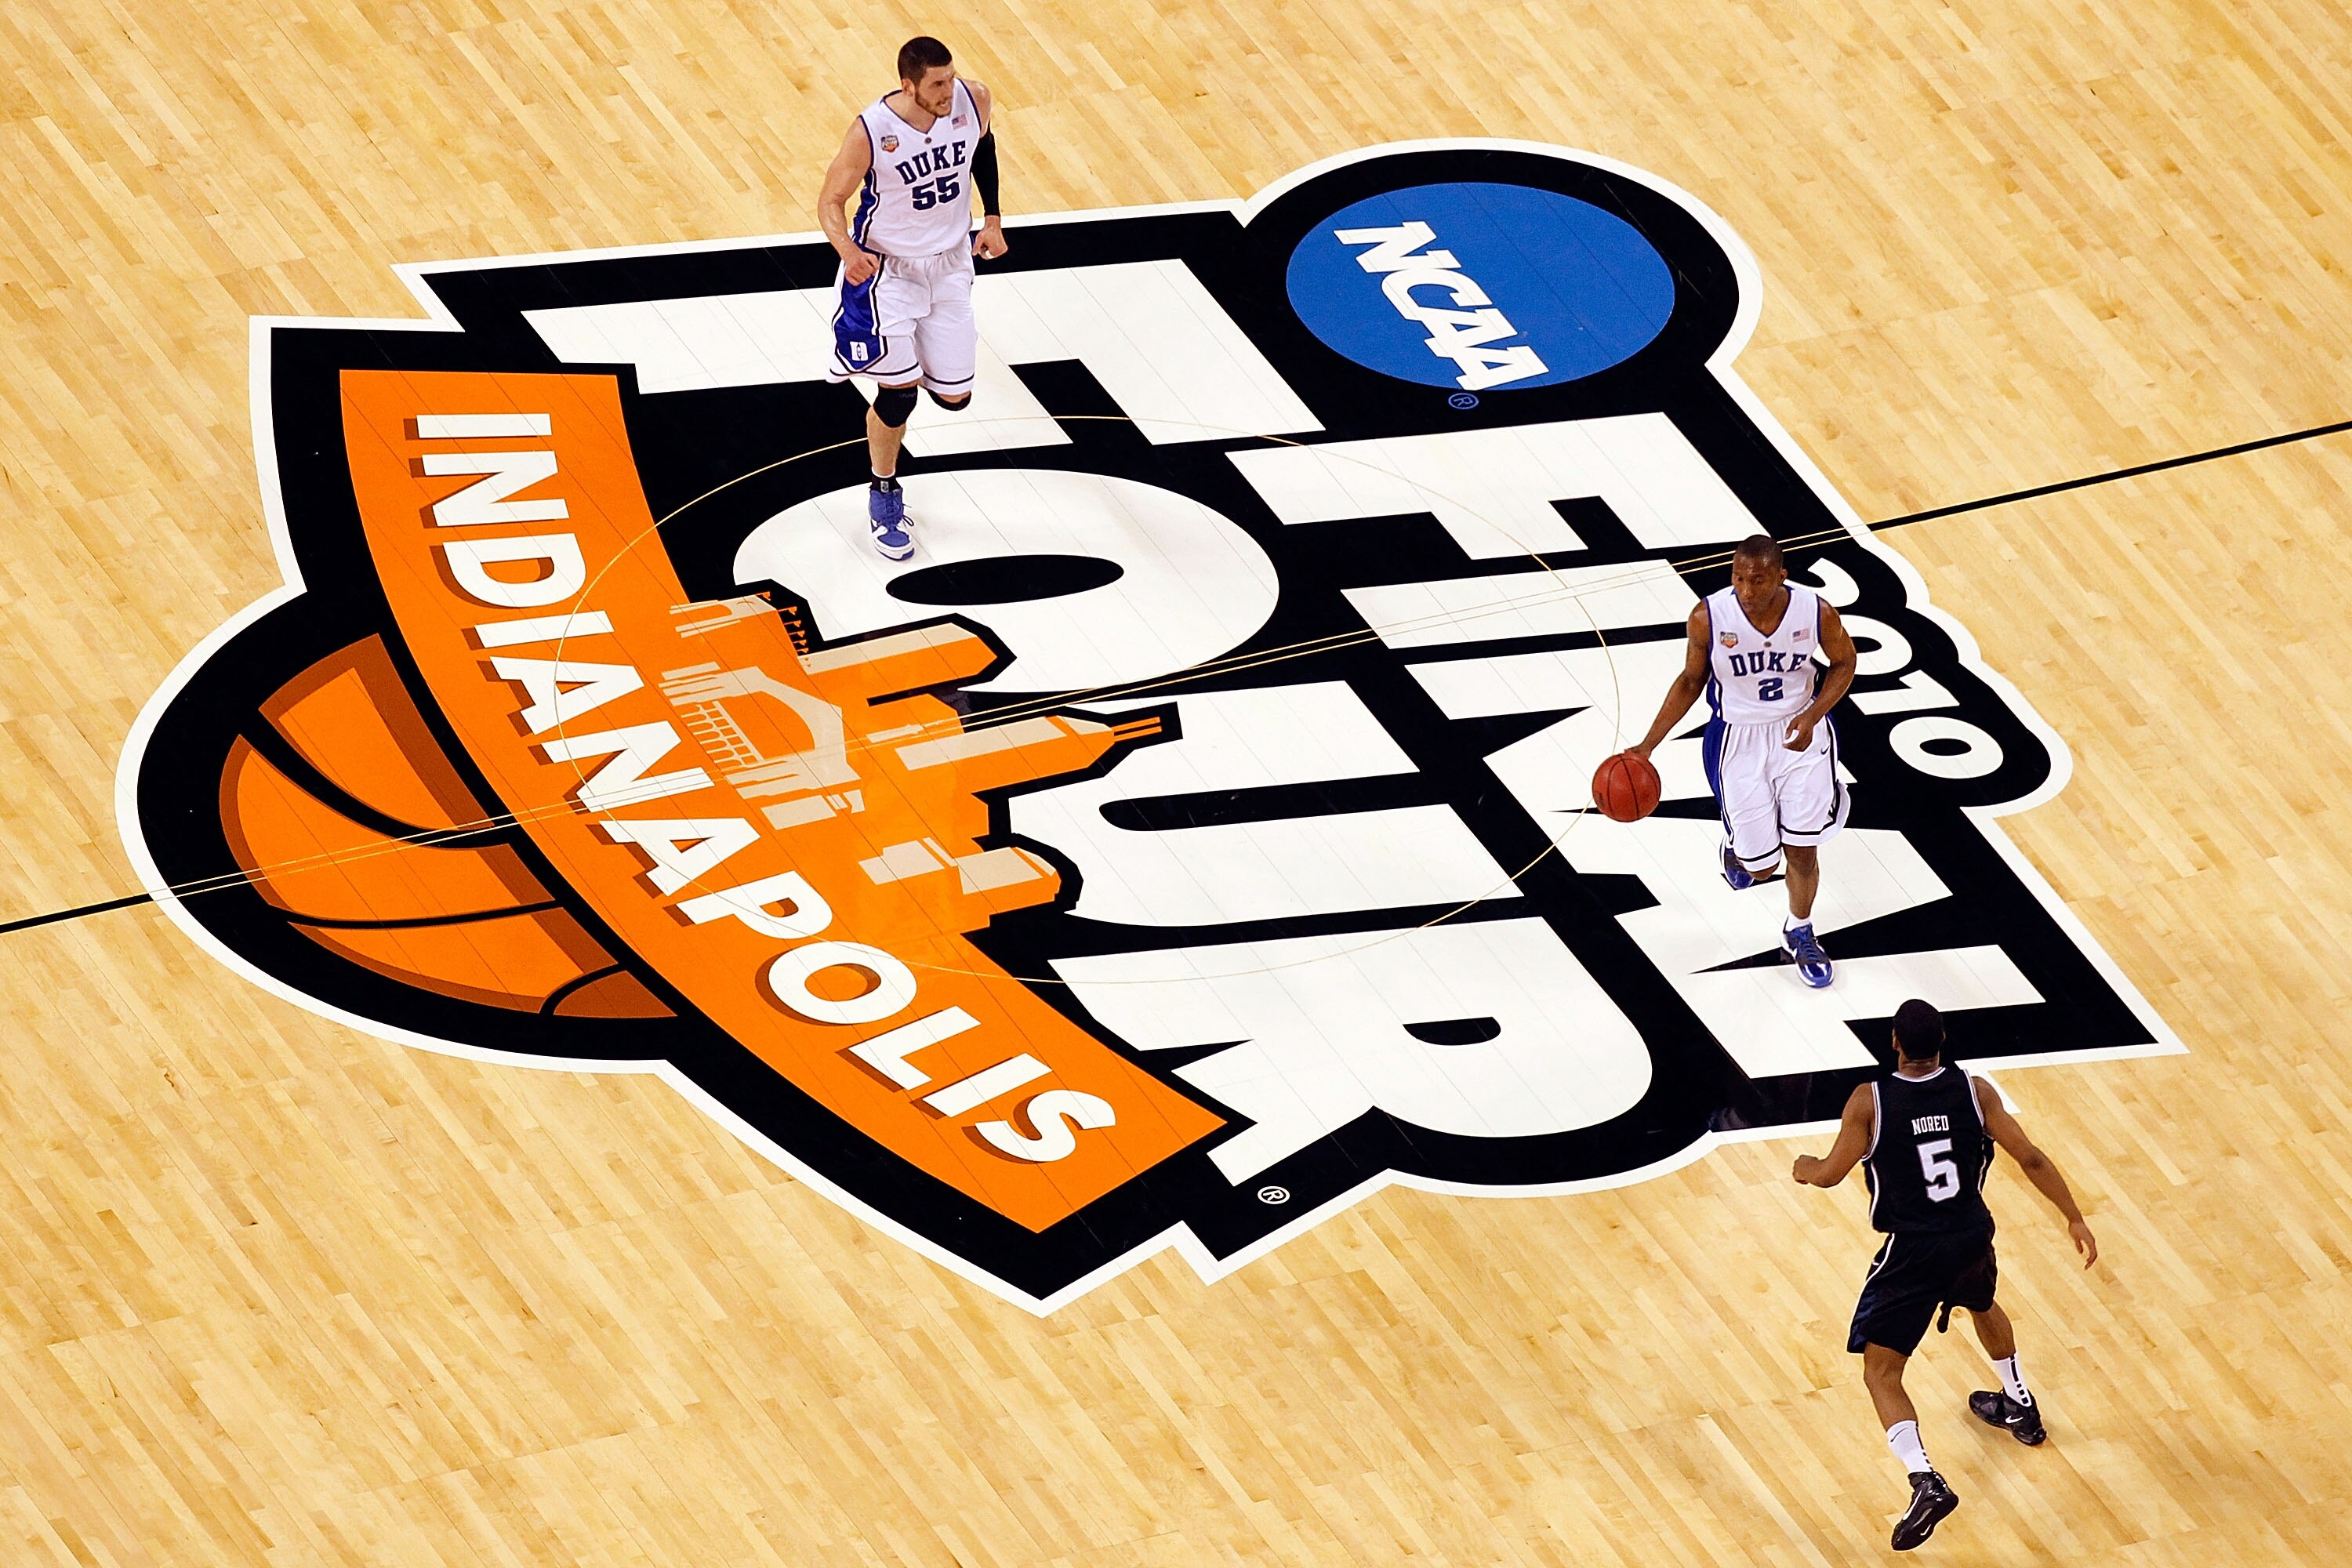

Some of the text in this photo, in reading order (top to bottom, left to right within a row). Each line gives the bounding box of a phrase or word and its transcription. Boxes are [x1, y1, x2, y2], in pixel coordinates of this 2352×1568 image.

[895, 140, 966, 185] DUKE
[912, 172, 960, 211] 55
[1334, 220, 1549, 390] NCAA
[1729, 651, 1808, 677] DUKE
[1758, 677, 1784, 702] 2
[521, 259, 1653, 1185] FOUR
[1225, 412, 2046, 1078] FINAL
[408, 413, 1116, 1162] INDIANAPOLIS
[1911, 1114, 1949, 1135] NORED
[1916, 1138, 1961, 1203] 5
